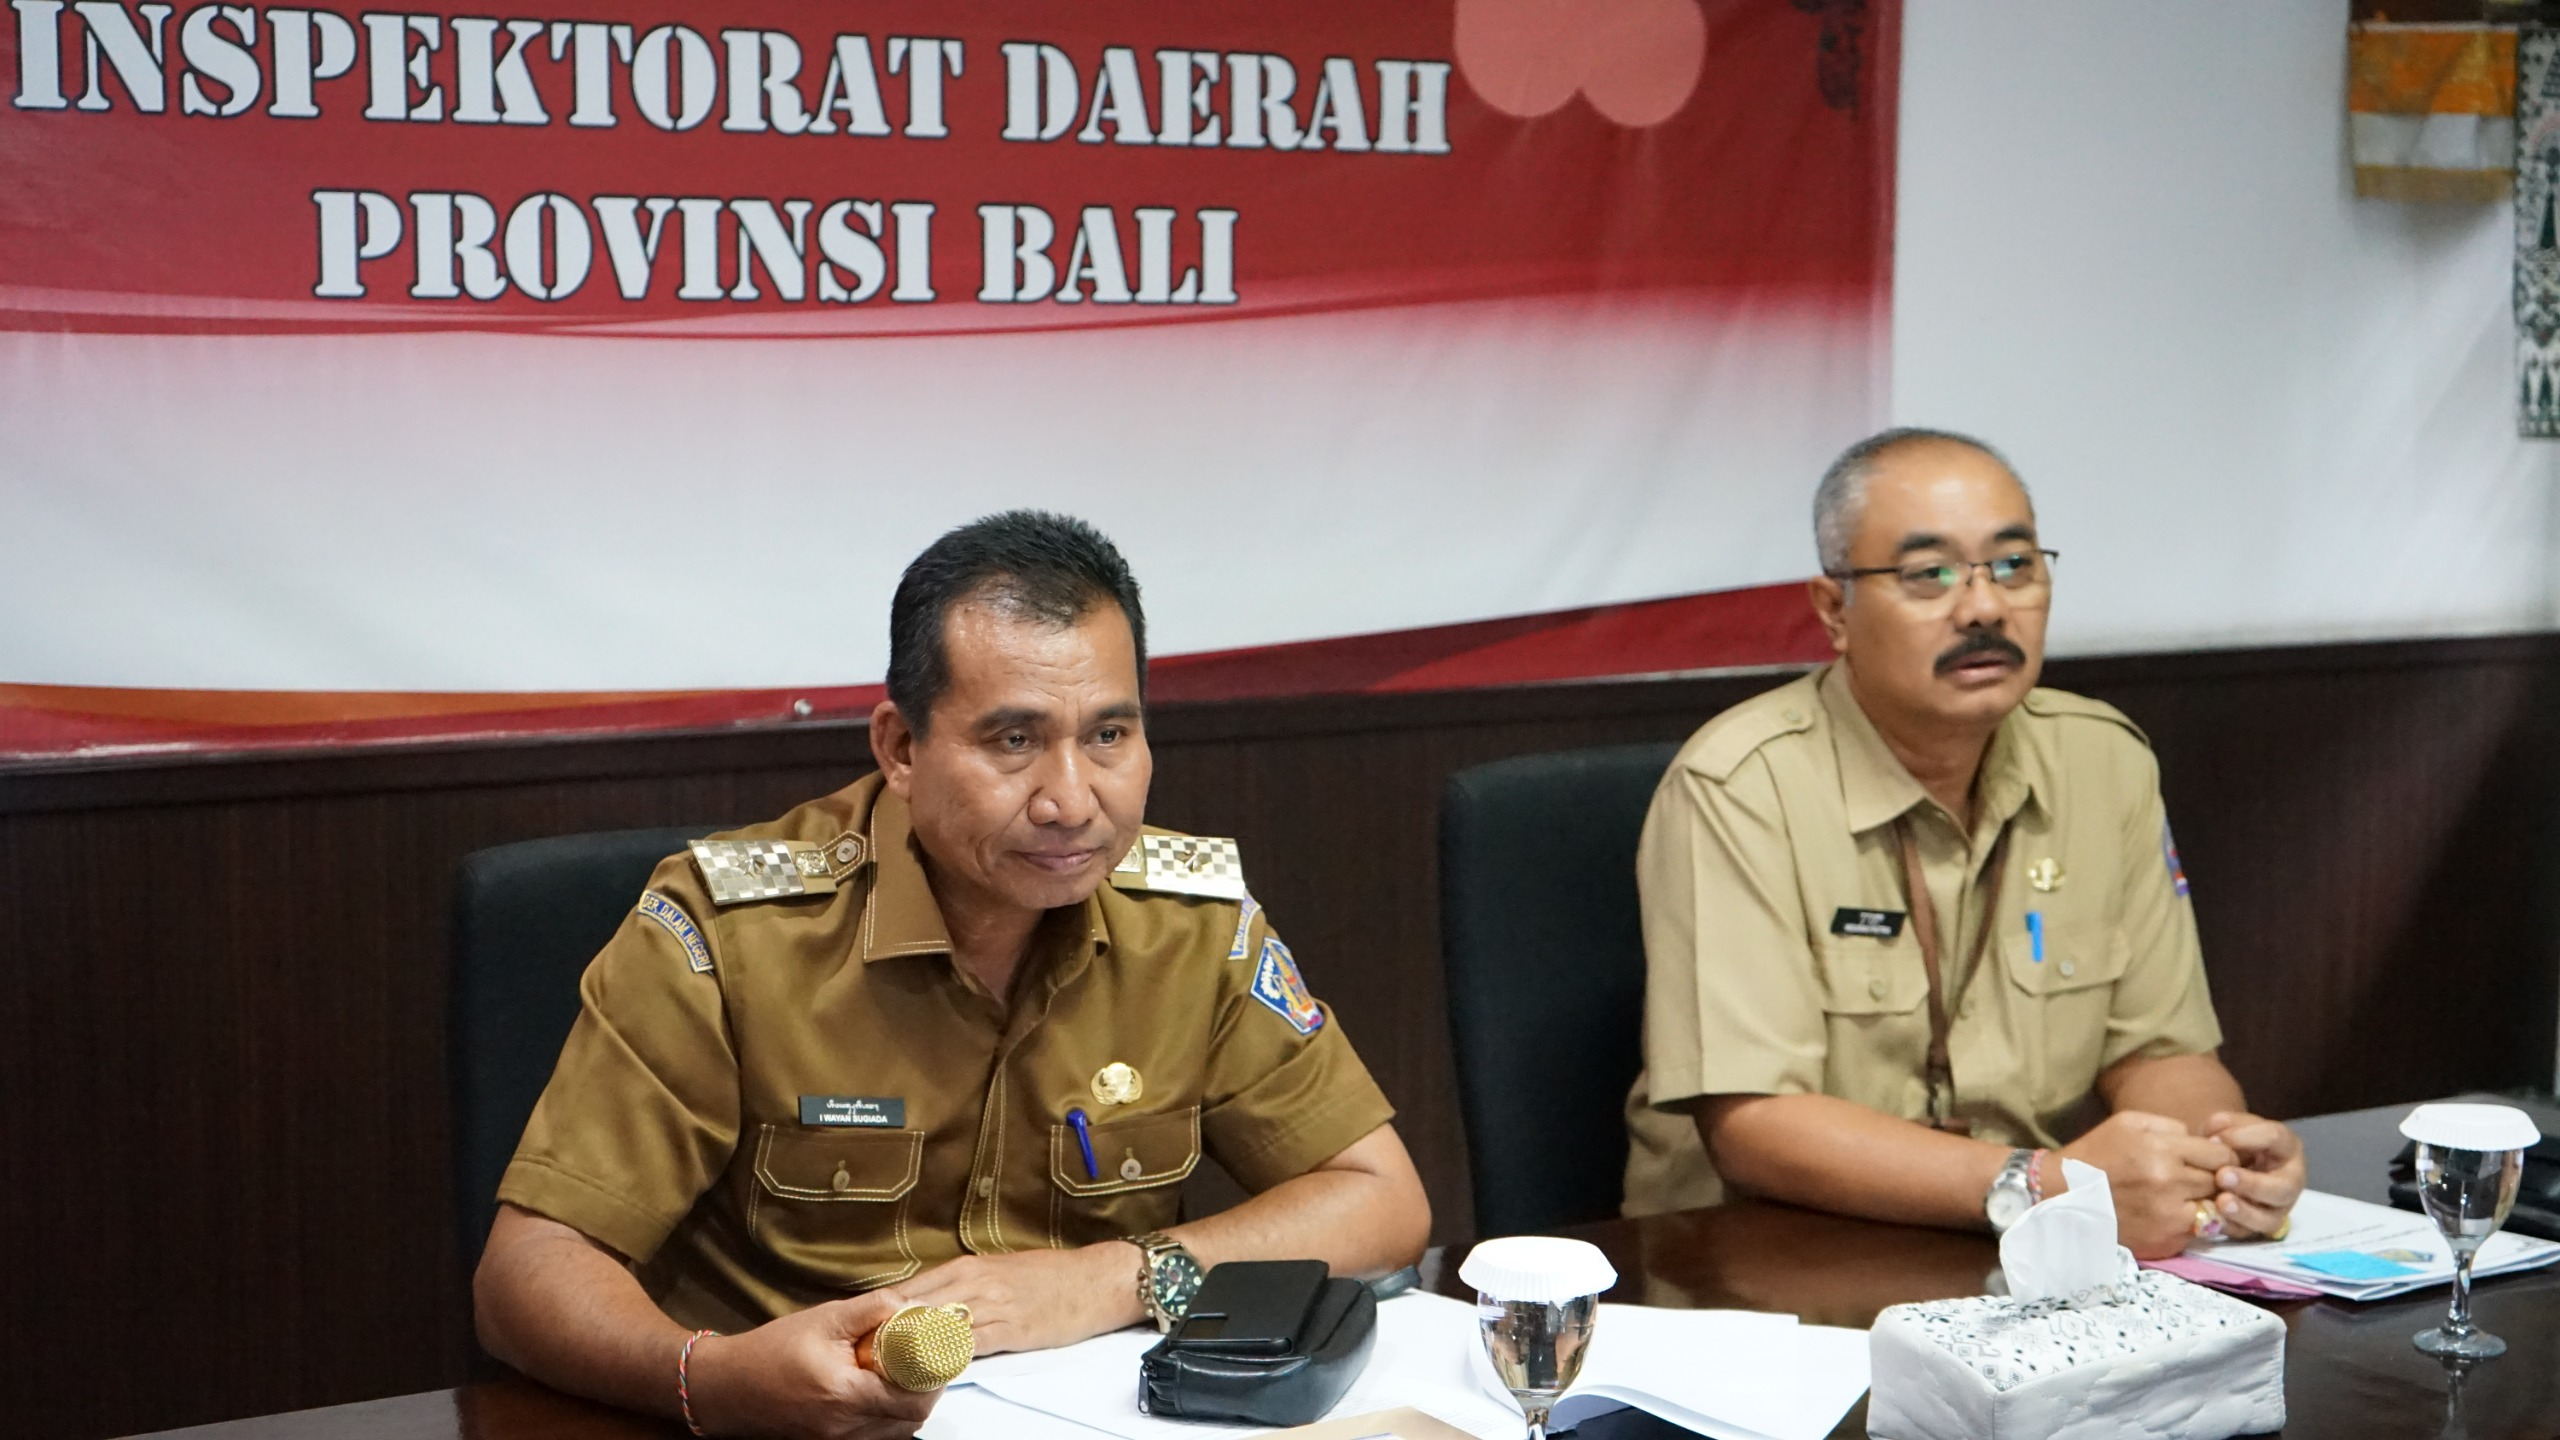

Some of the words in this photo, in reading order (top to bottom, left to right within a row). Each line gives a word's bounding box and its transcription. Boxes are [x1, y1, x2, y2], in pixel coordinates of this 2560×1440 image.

[11, 0, 963, 138] INSPEKTORAT
[1001, 43, 1450, 153] DAERAH
[312, 191, 936, 303] PROVINSI
[978, 205, 1238, 304] BALI
[659, 904, 690, 935] DALAM
[683, 931, 710, 967] NEGERI
[823, 1114, 851, 1122] WAYAN
